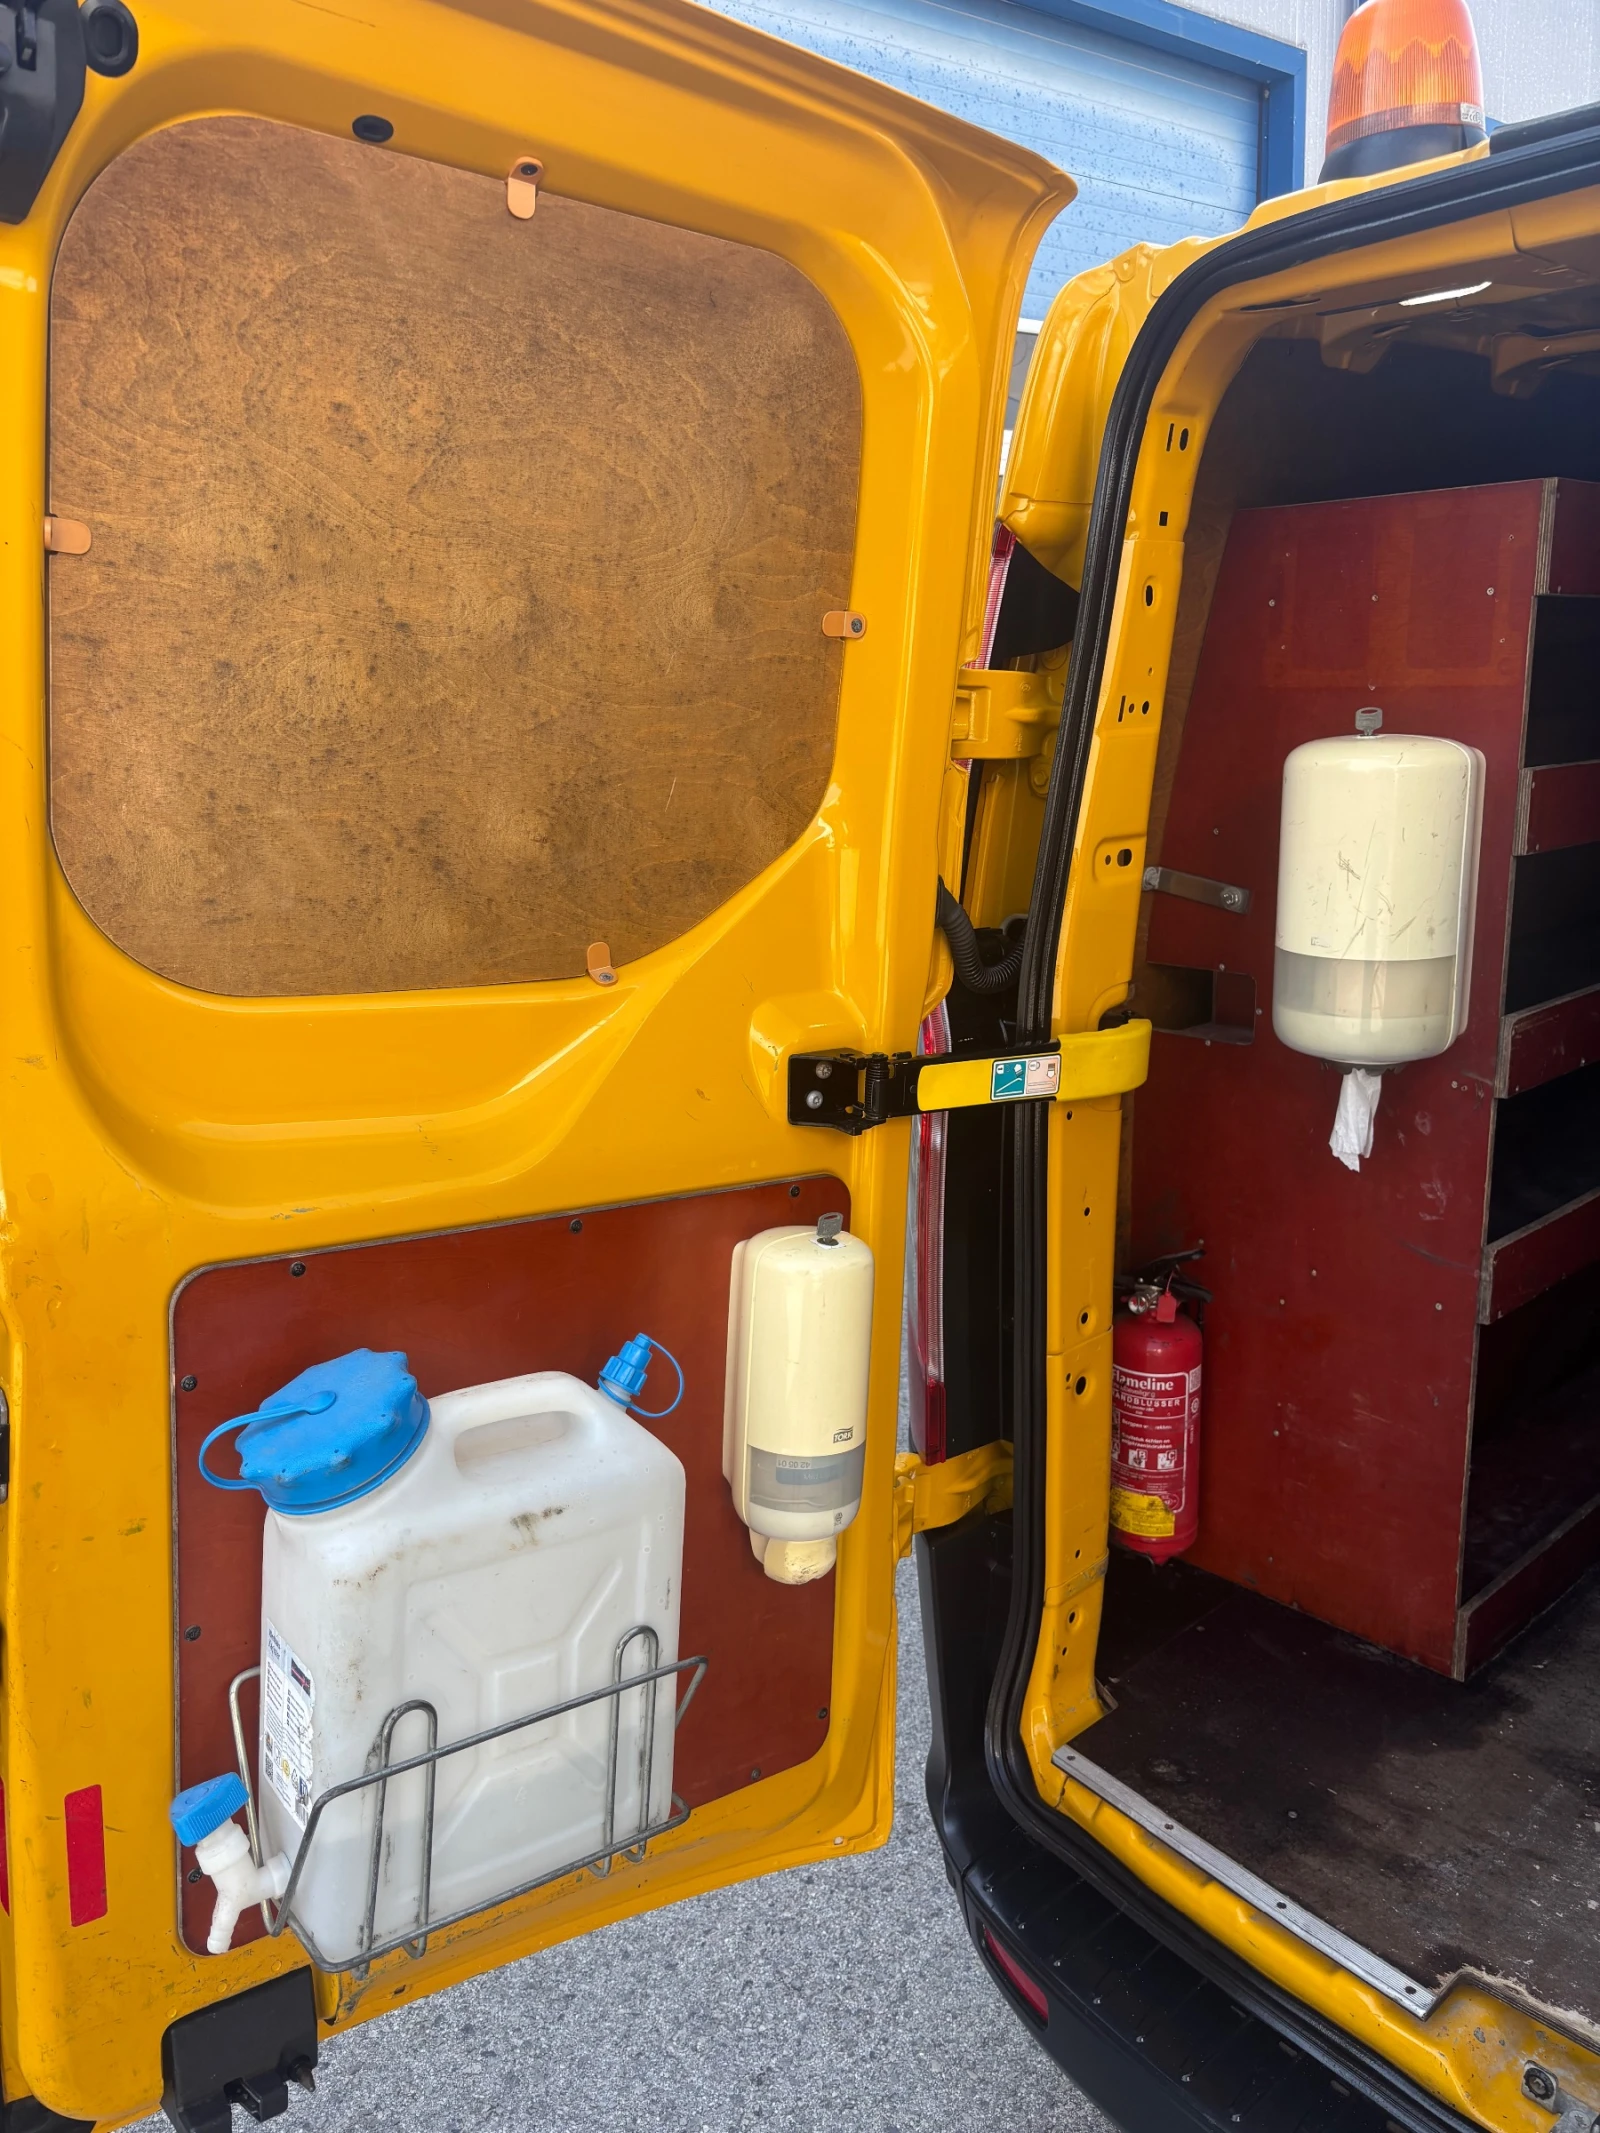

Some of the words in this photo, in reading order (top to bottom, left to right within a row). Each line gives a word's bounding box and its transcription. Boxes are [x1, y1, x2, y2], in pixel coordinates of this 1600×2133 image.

[834, 1431, 853, 1442] TORK
[1138, 1450, 1146, 1458] B
[1168, 1451, 1175, 1460] C
